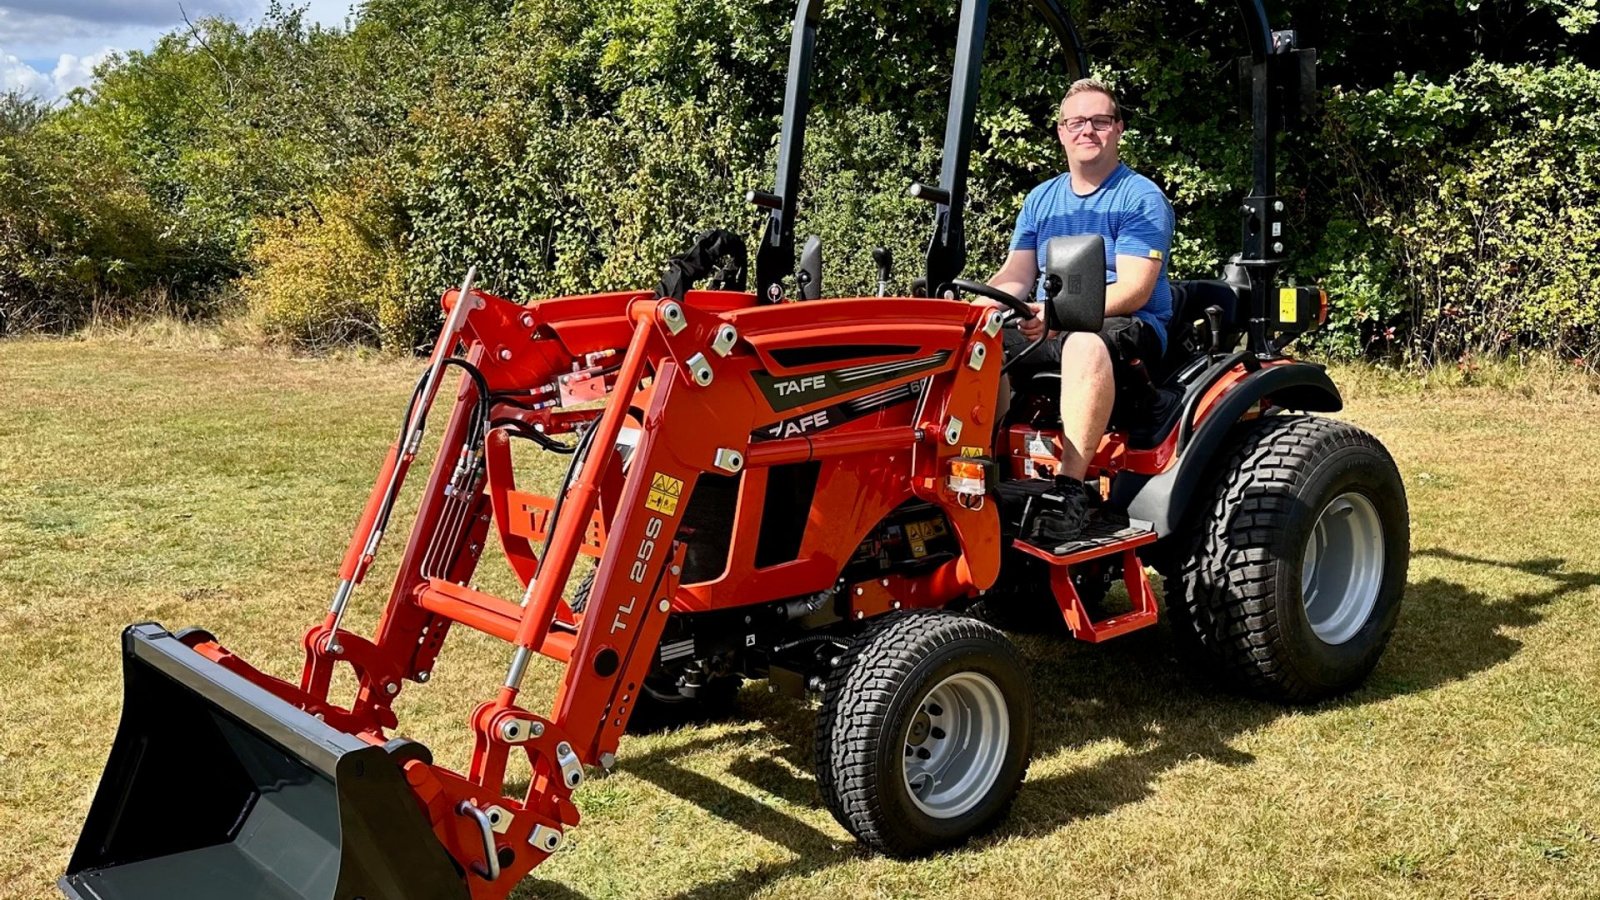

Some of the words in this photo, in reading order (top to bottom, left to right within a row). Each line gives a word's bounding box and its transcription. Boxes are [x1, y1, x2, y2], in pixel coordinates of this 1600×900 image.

[774, 375, 826, 396] TAFE
[610, 597, 636, 634] TL
[630, 517, 663, 583] 25S
